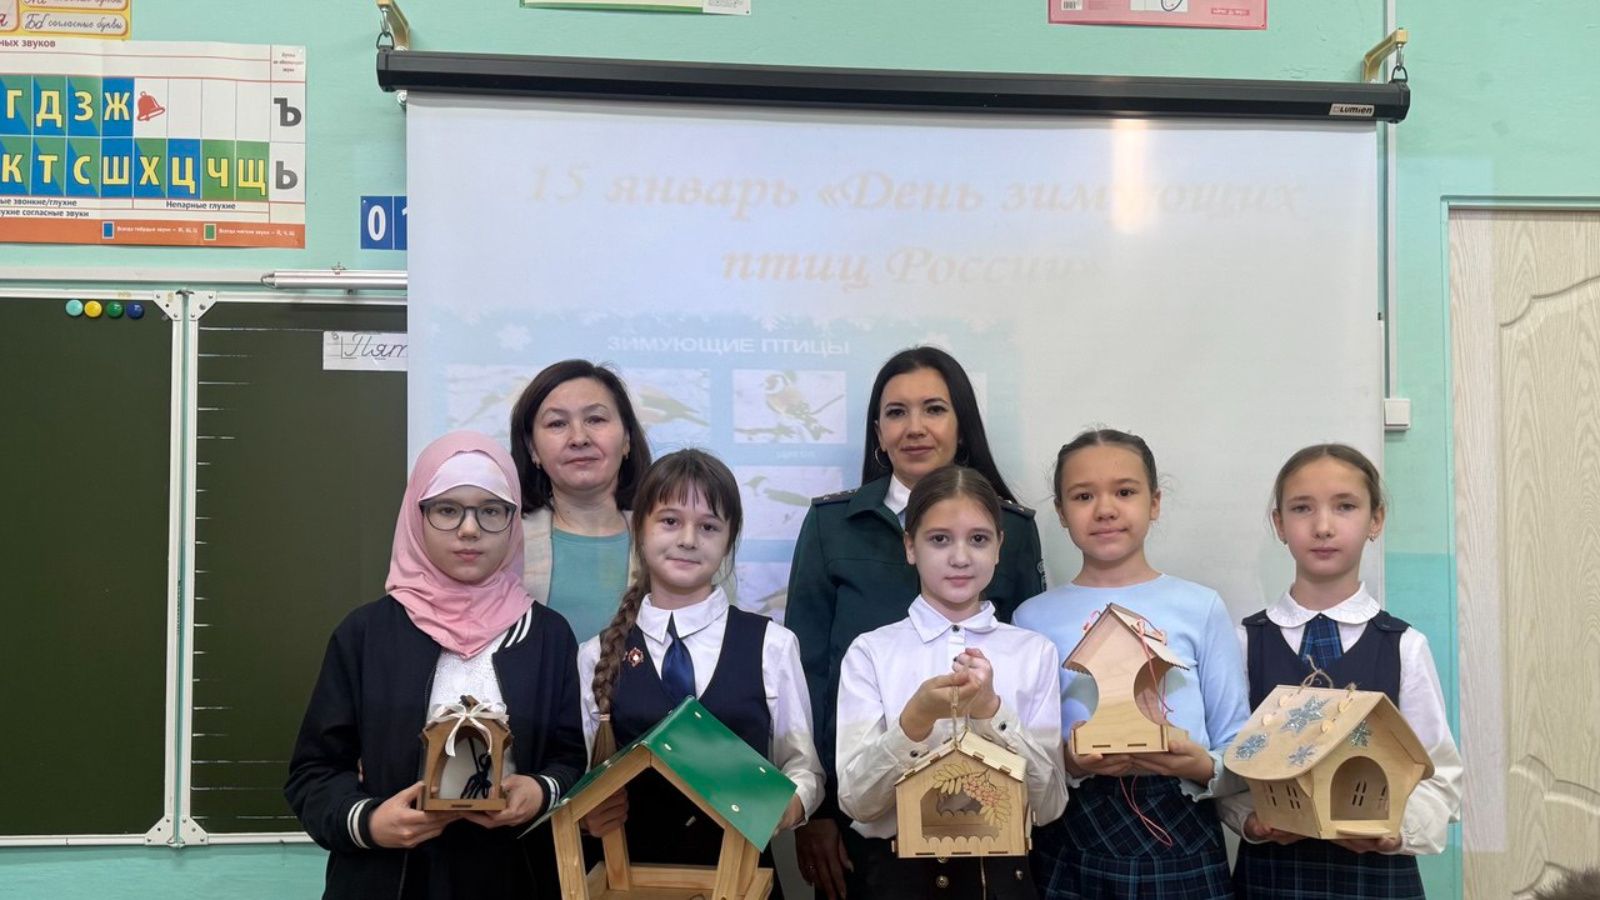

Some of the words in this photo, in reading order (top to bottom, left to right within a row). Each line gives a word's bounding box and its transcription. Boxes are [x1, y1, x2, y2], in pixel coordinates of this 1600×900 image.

[21, 40, 56, 48] звуков
[6, 89, 22, 119] Г
[36, 90, 62, 128] Д
[74, 91, 94, 121] З
[104, 92, 131, 121] Ж
[274, 97, 302, 127] Ъ
[1, 154, 23, 182] К
[38, 155, 58, 183] Т
[73, 155, 91, 183] С
[103, 156, 130, 184] Ш
[139, 156, 160, 185] Х
[172, 157, 195, 194] Ц
[207, 158, 229, 187] Ч
[238, 159, 266, 195] Щ
[275, 160, 298, 189] Ь
[530, 161, 592, 201] 15
[604, 173, 799, 221] январь
[817, 169, 985, 211] «День
[14, 199, 78, 208] звонкие/глухие
[22, 209, 64, 217] согласные
[166, 200, 207, 211] Непарные
[208, 203, 236, 211] глухие
[721, 249, 874, 294] птиц
[607, 336, 755, 355] ЗИМУЮЩИЕ
[761, 338, 850, 358] ПТИЦЫ
